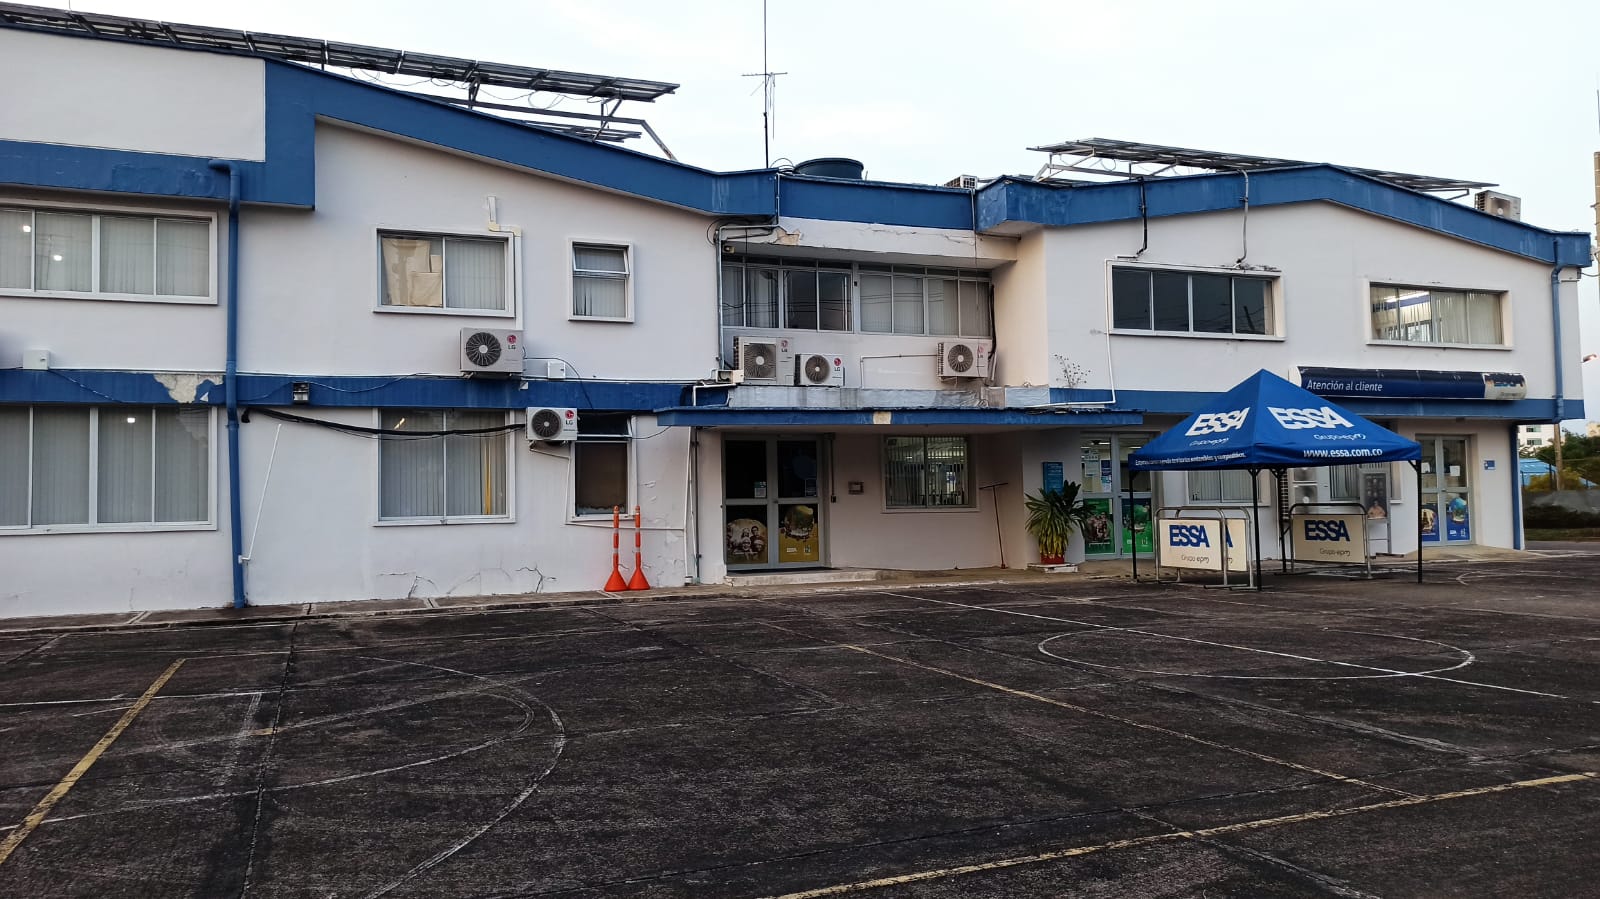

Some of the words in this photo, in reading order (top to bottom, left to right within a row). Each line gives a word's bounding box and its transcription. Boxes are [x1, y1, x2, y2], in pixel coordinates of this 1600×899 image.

[1306, 380, 1344, 391] Atención
[1345, 381, 1353, 391] al
[1355, 381, 1383, 392] cliente
[1185, 407, 1250, 436] ESSA
[1266, 406, 1355, 430] ESSA
[1303, 448, 1383, 458] www.essa.com.co
[1169, 524, 1210, 548] ESSA
[1304, 520, 1350, 542] ESSA
